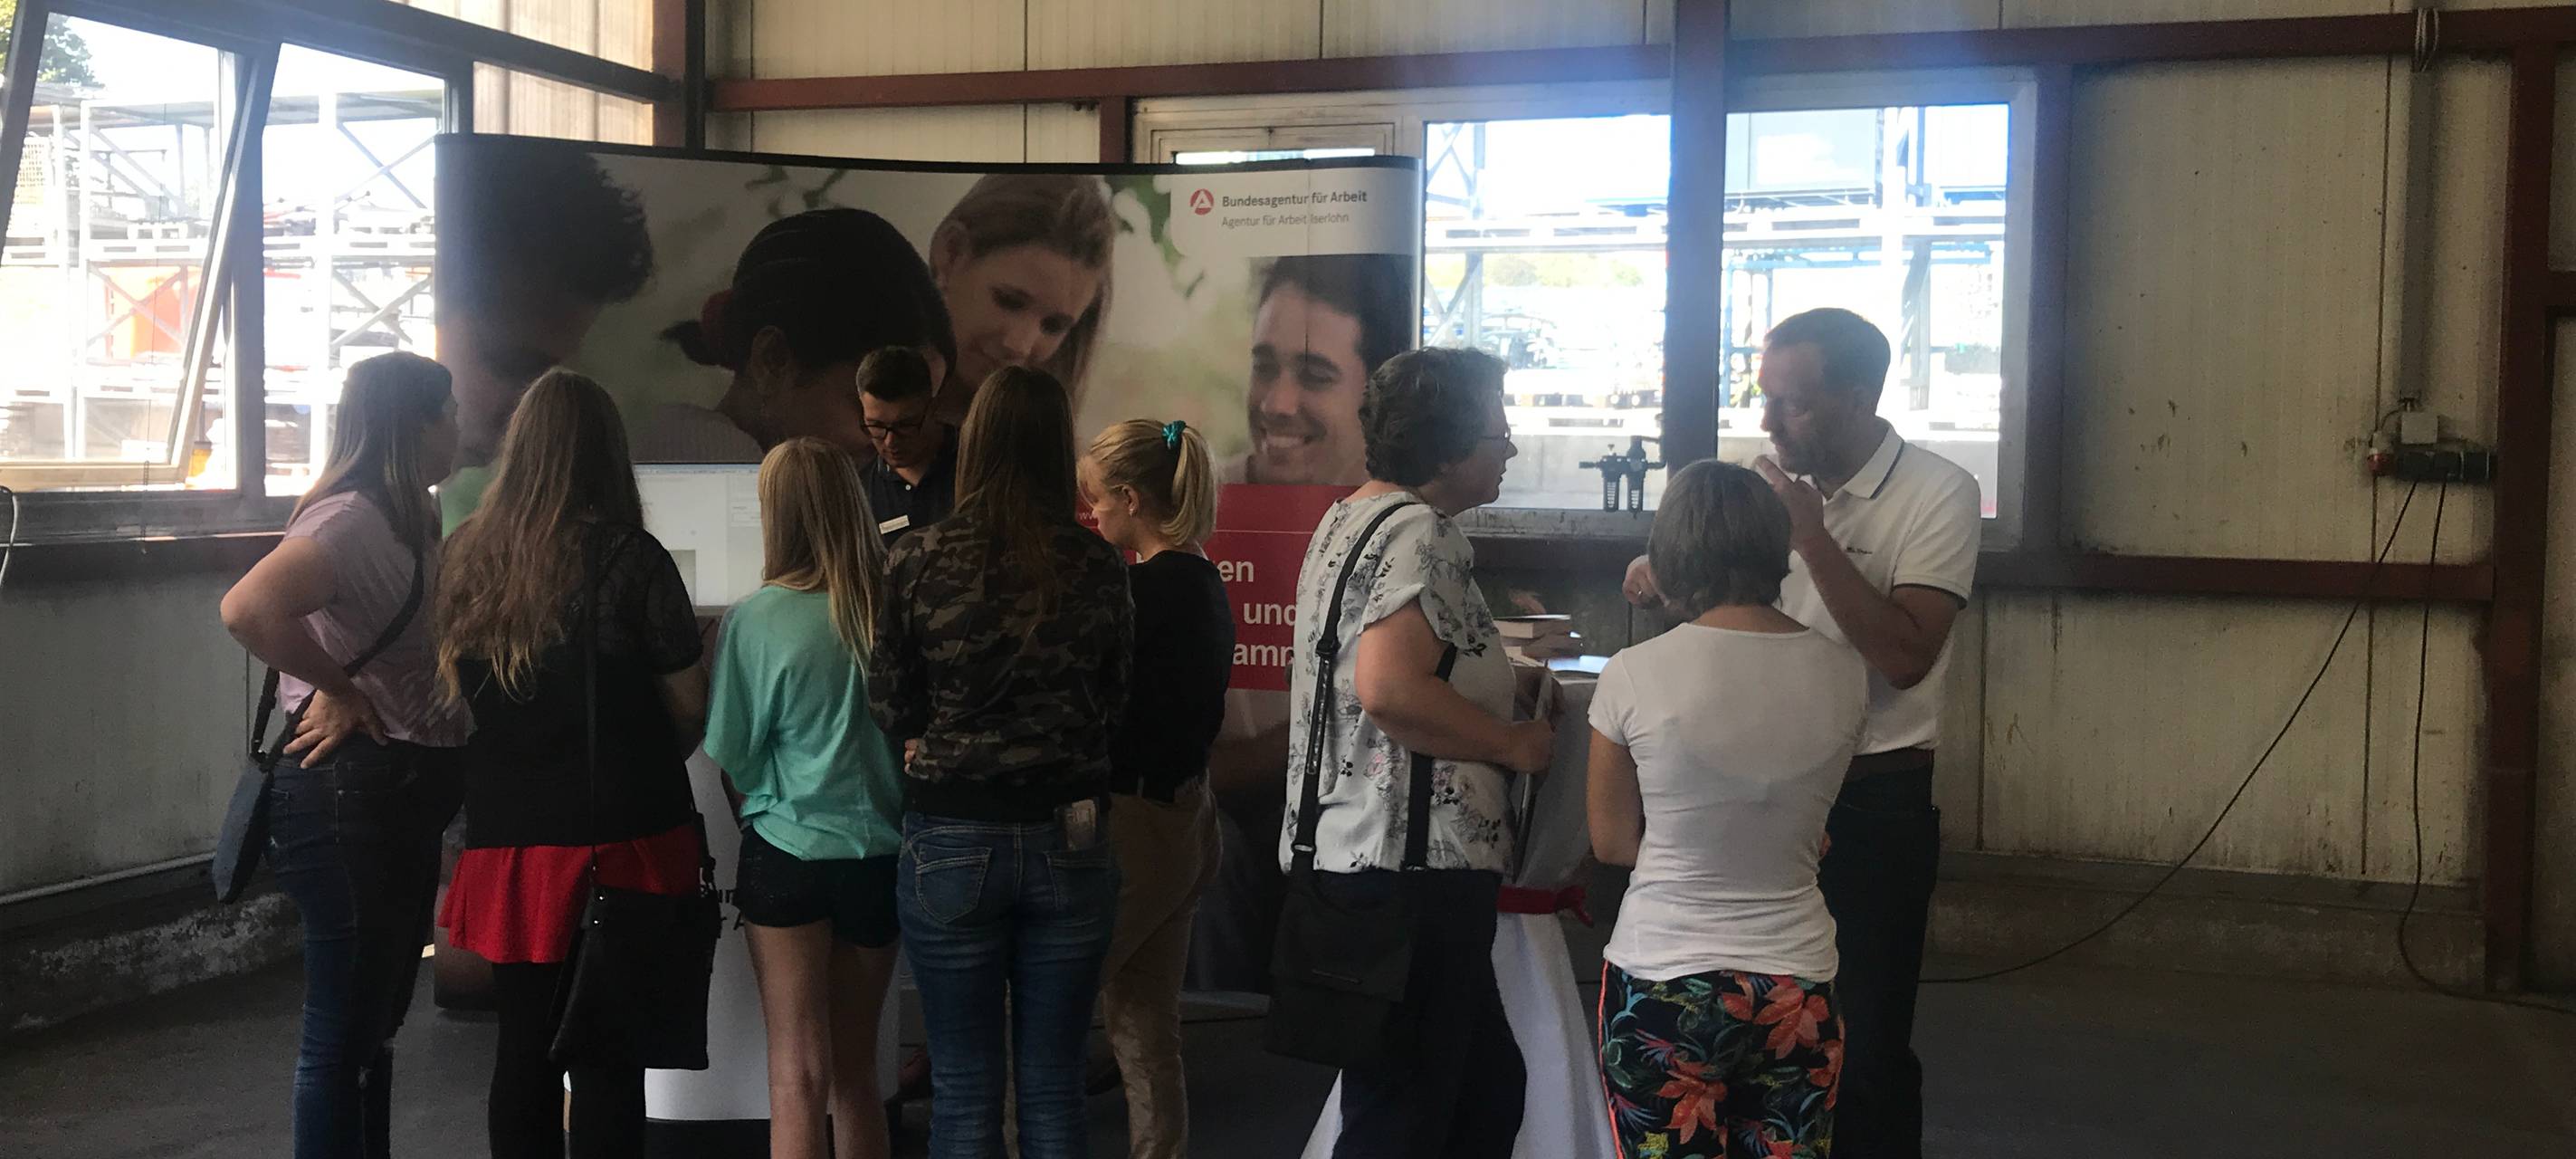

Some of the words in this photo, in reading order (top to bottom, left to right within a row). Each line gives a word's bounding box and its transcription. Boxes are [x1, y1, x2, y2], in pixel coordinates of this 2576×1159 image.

[1222, 193, 1309, 208] Bundesagentur
[1312, 191, 1329, 204] für
[1330, 190, 1369, 203] Arbeit
[1222, 216, 1260, 228] Agentur
[1262, 215, 1276, 226] für
[1278, 214, 1307, 225] Arbeit
